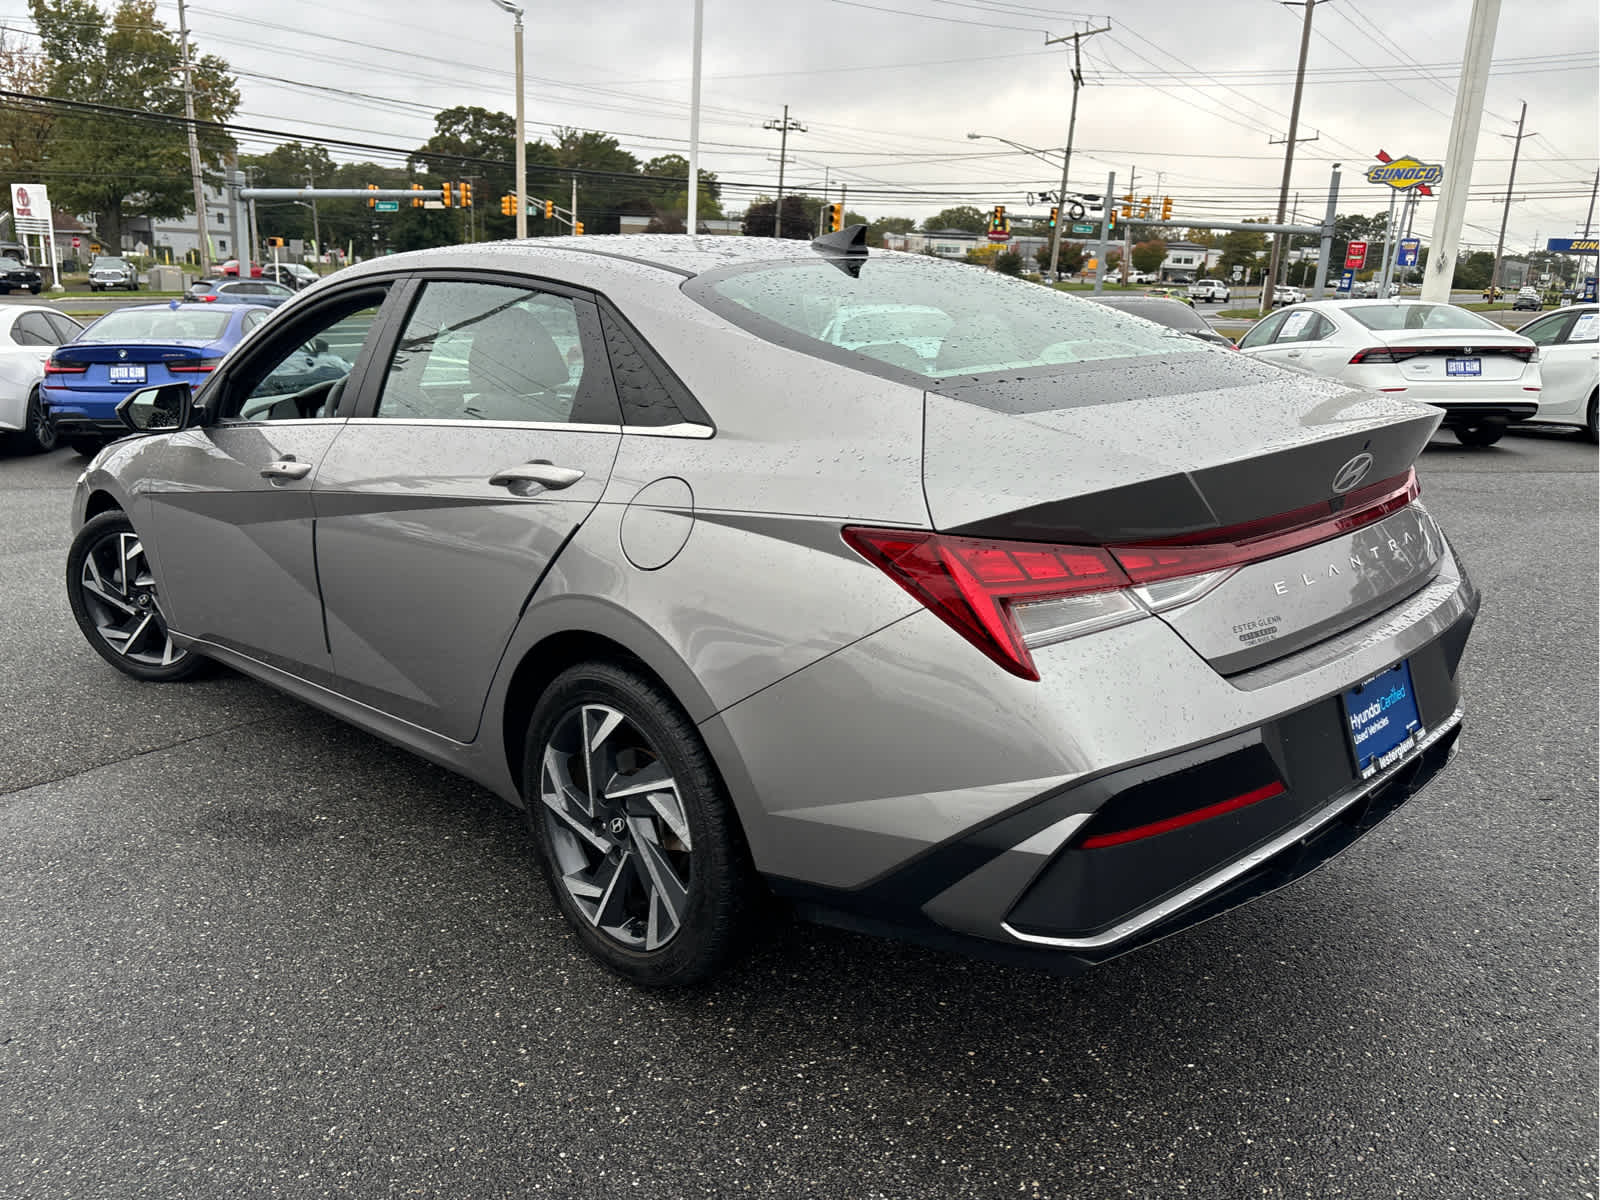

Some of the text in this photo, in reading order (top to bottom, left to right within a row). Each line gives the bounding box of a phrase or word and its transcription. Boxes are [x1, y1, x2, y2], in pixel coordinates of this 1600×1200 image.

[1370, 167, 1439, 181] SUNOCO
[1569, 240, 1600, 250] SUN
[1273, 531, 1417, 596] ELANTRA
[1258, 616, 1281, 626] GLENN
[1353, 727, 1369, 745] Used
[1368, 716, 1390, 736] Vehicles
